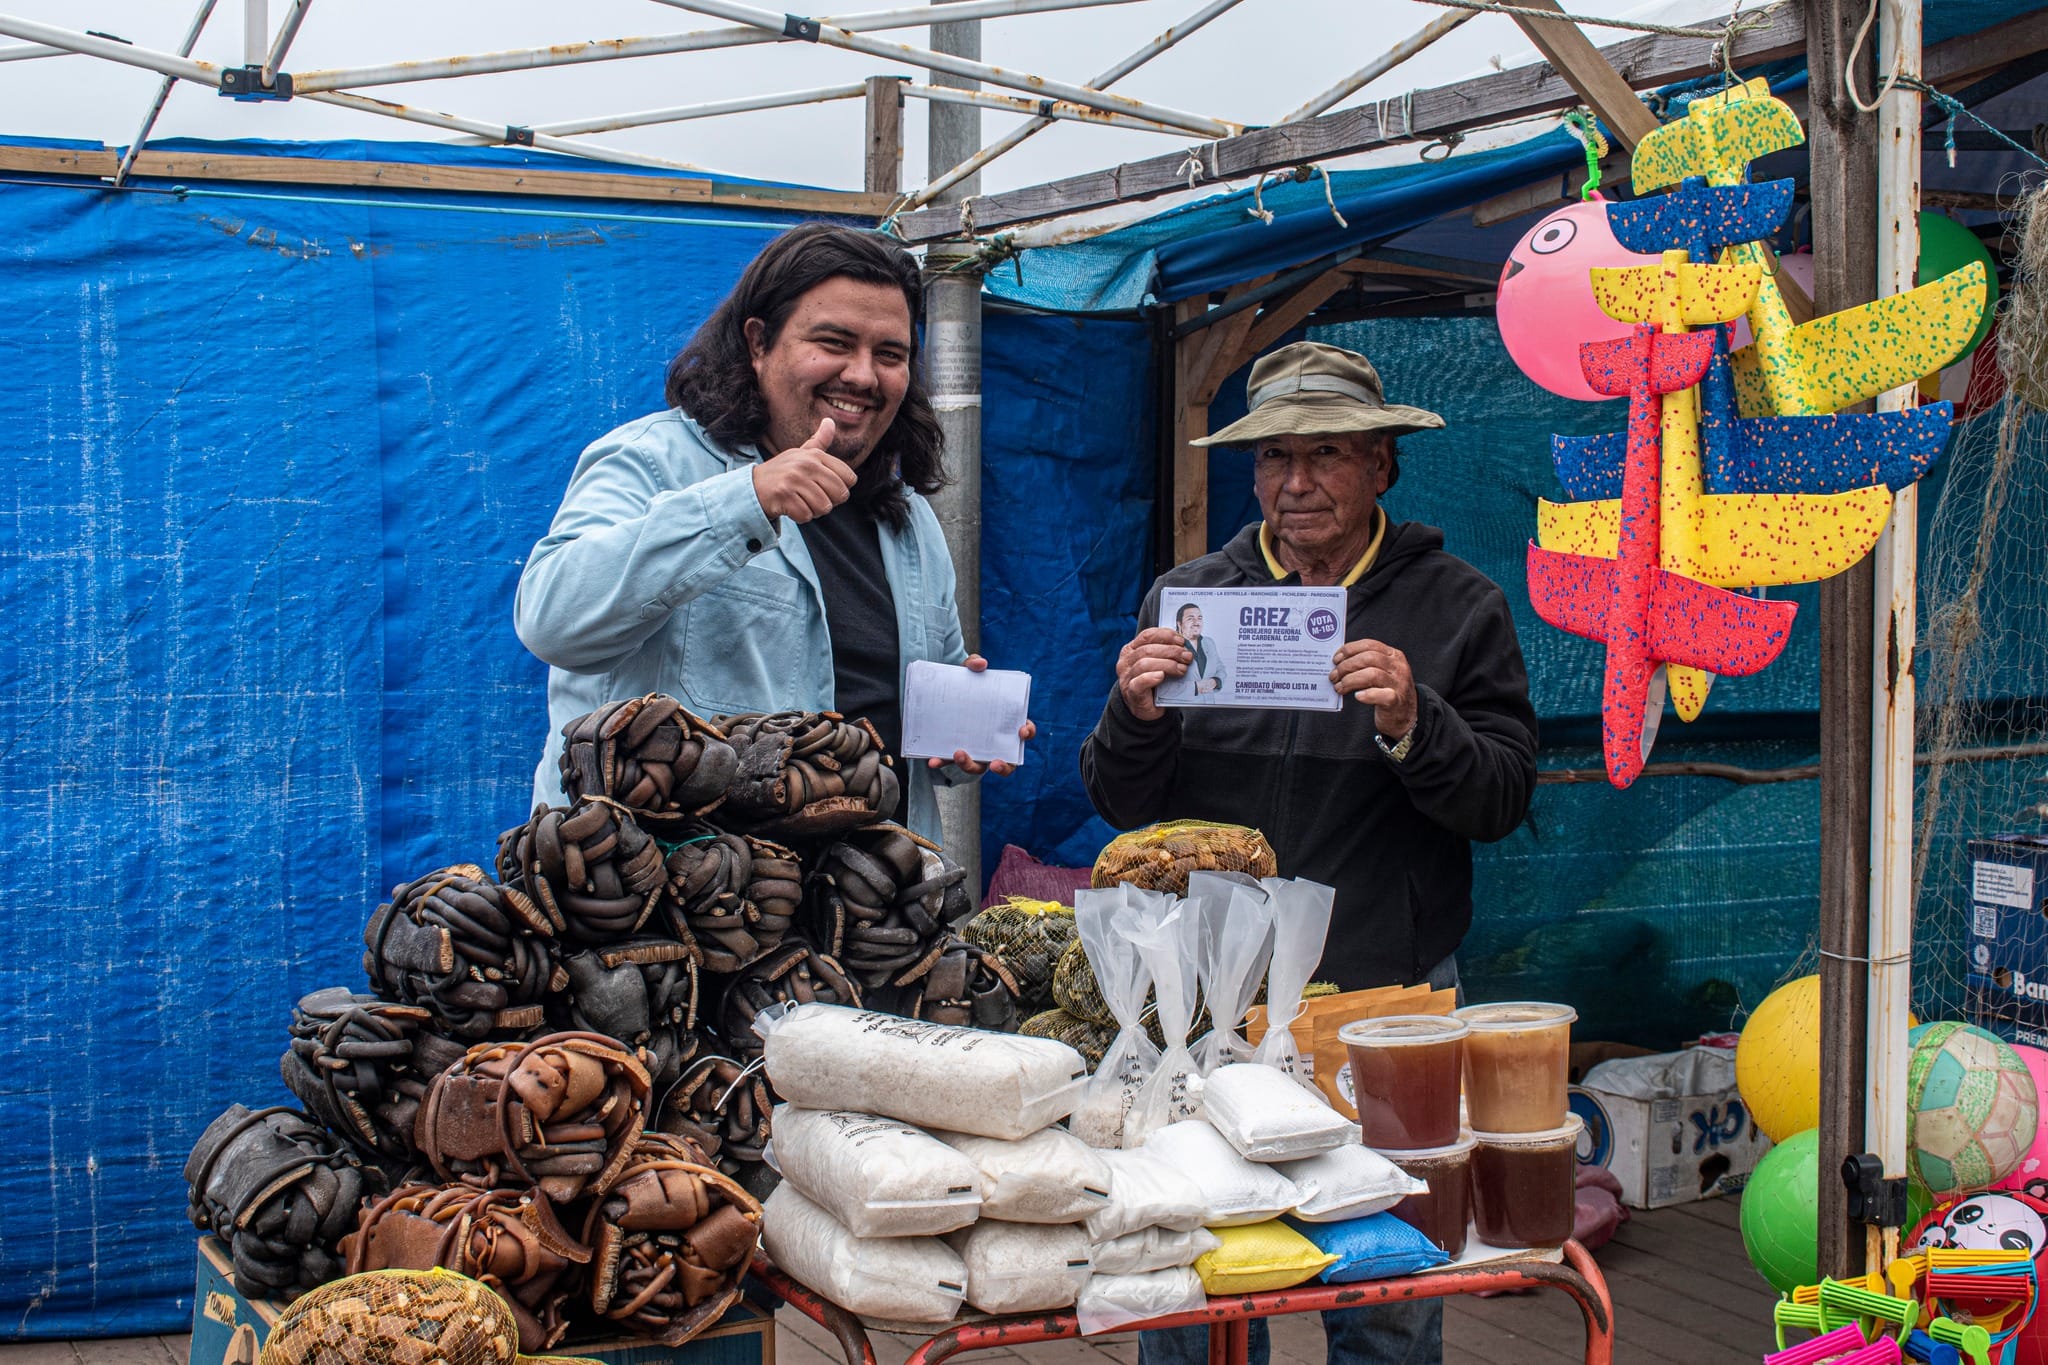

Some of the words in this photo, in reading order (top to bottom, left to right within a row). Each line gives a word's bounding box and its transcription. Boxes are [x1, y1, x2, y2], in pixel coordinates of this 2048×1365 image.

[1240, 606, 1291, 627] GREZ
[1310, 614, 1333, 626] VOTA
[1238, 627, 1272, 635] CONSEJERO
[1311, 623, 1335, 635] M-103
[1251, 634, 1282, 642] CARDENAL
[1235, 681, 1270, 689] CANDIDATO
[1271, 680, 1291, 690] ÚNICO
[1292, 682, 1309, 690] LISTA
[1310, 683, 1317, 691] M
